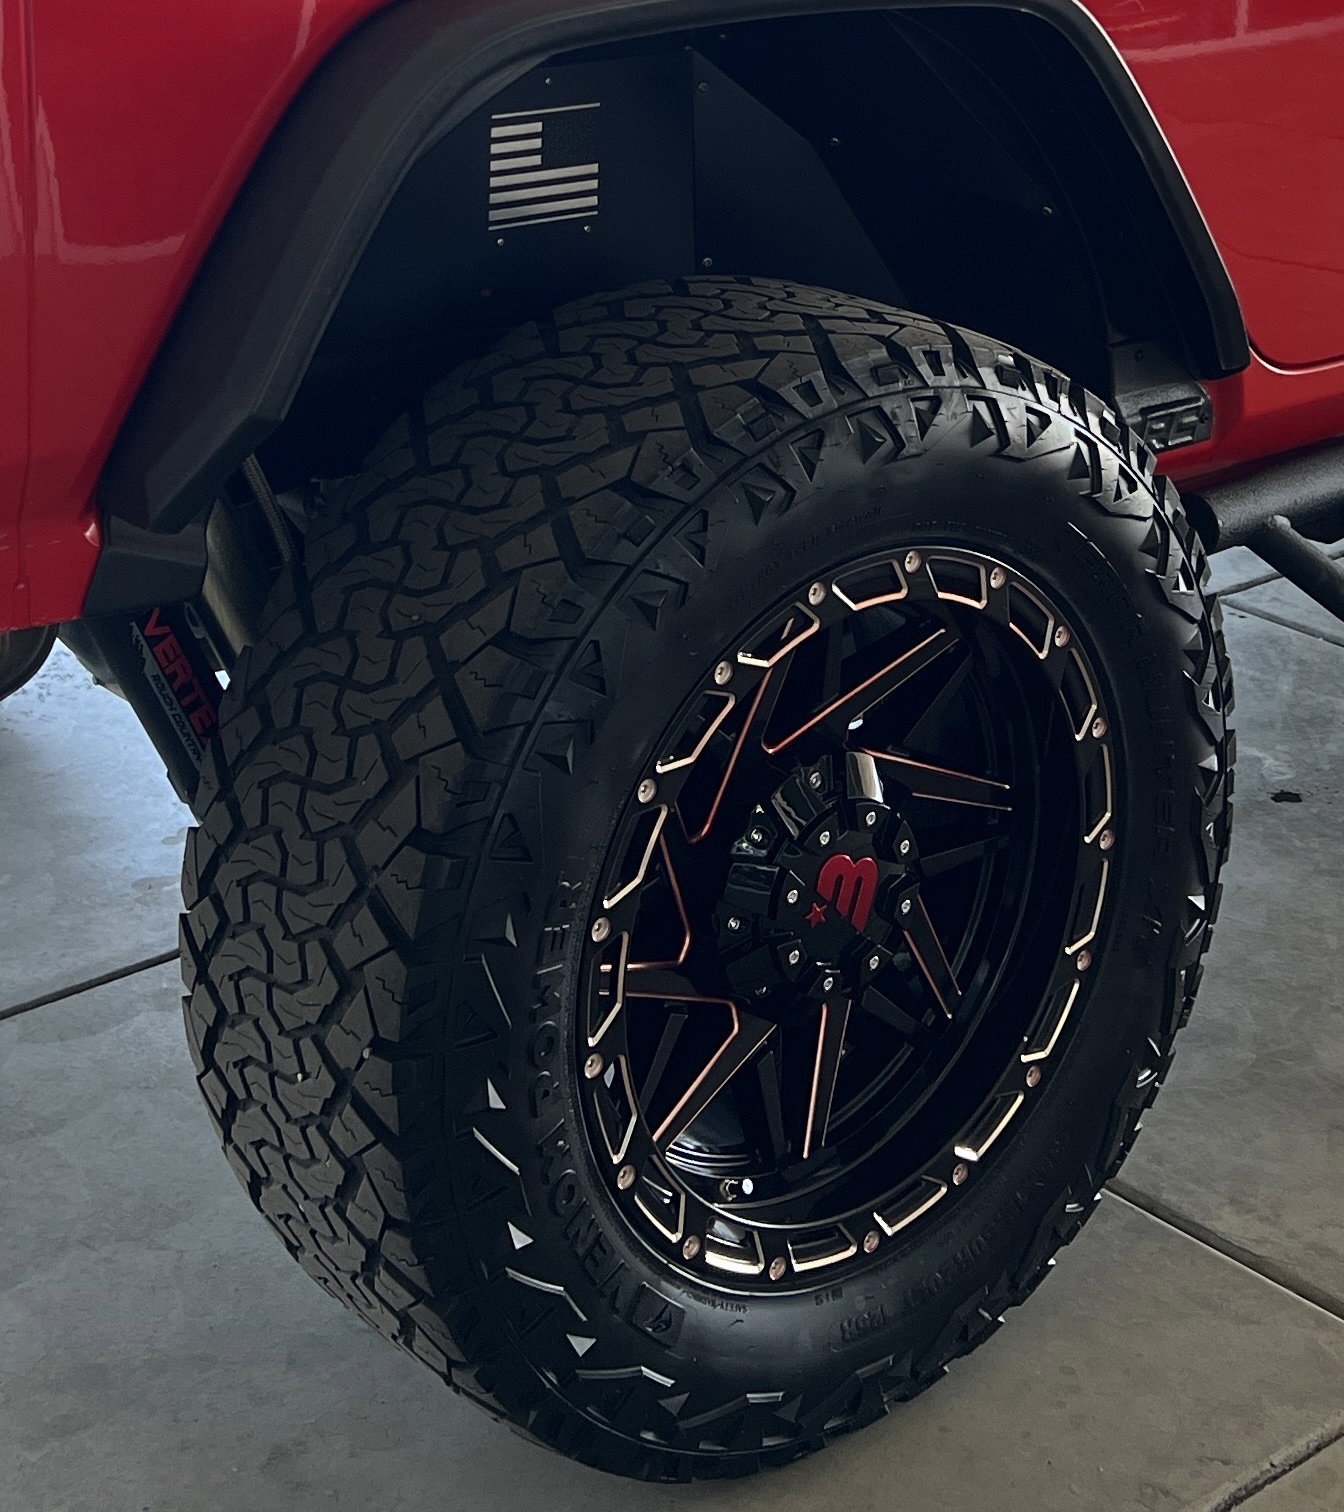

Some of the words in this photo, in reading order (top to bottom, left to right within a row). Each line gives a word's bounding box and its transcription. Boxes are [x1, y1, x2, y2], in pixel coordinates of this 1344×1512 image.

[144, 606, 218, 744] VERTE
[528, 880, 583, 1118] POWER
[536, 1118, 628, 1321] VENOM
